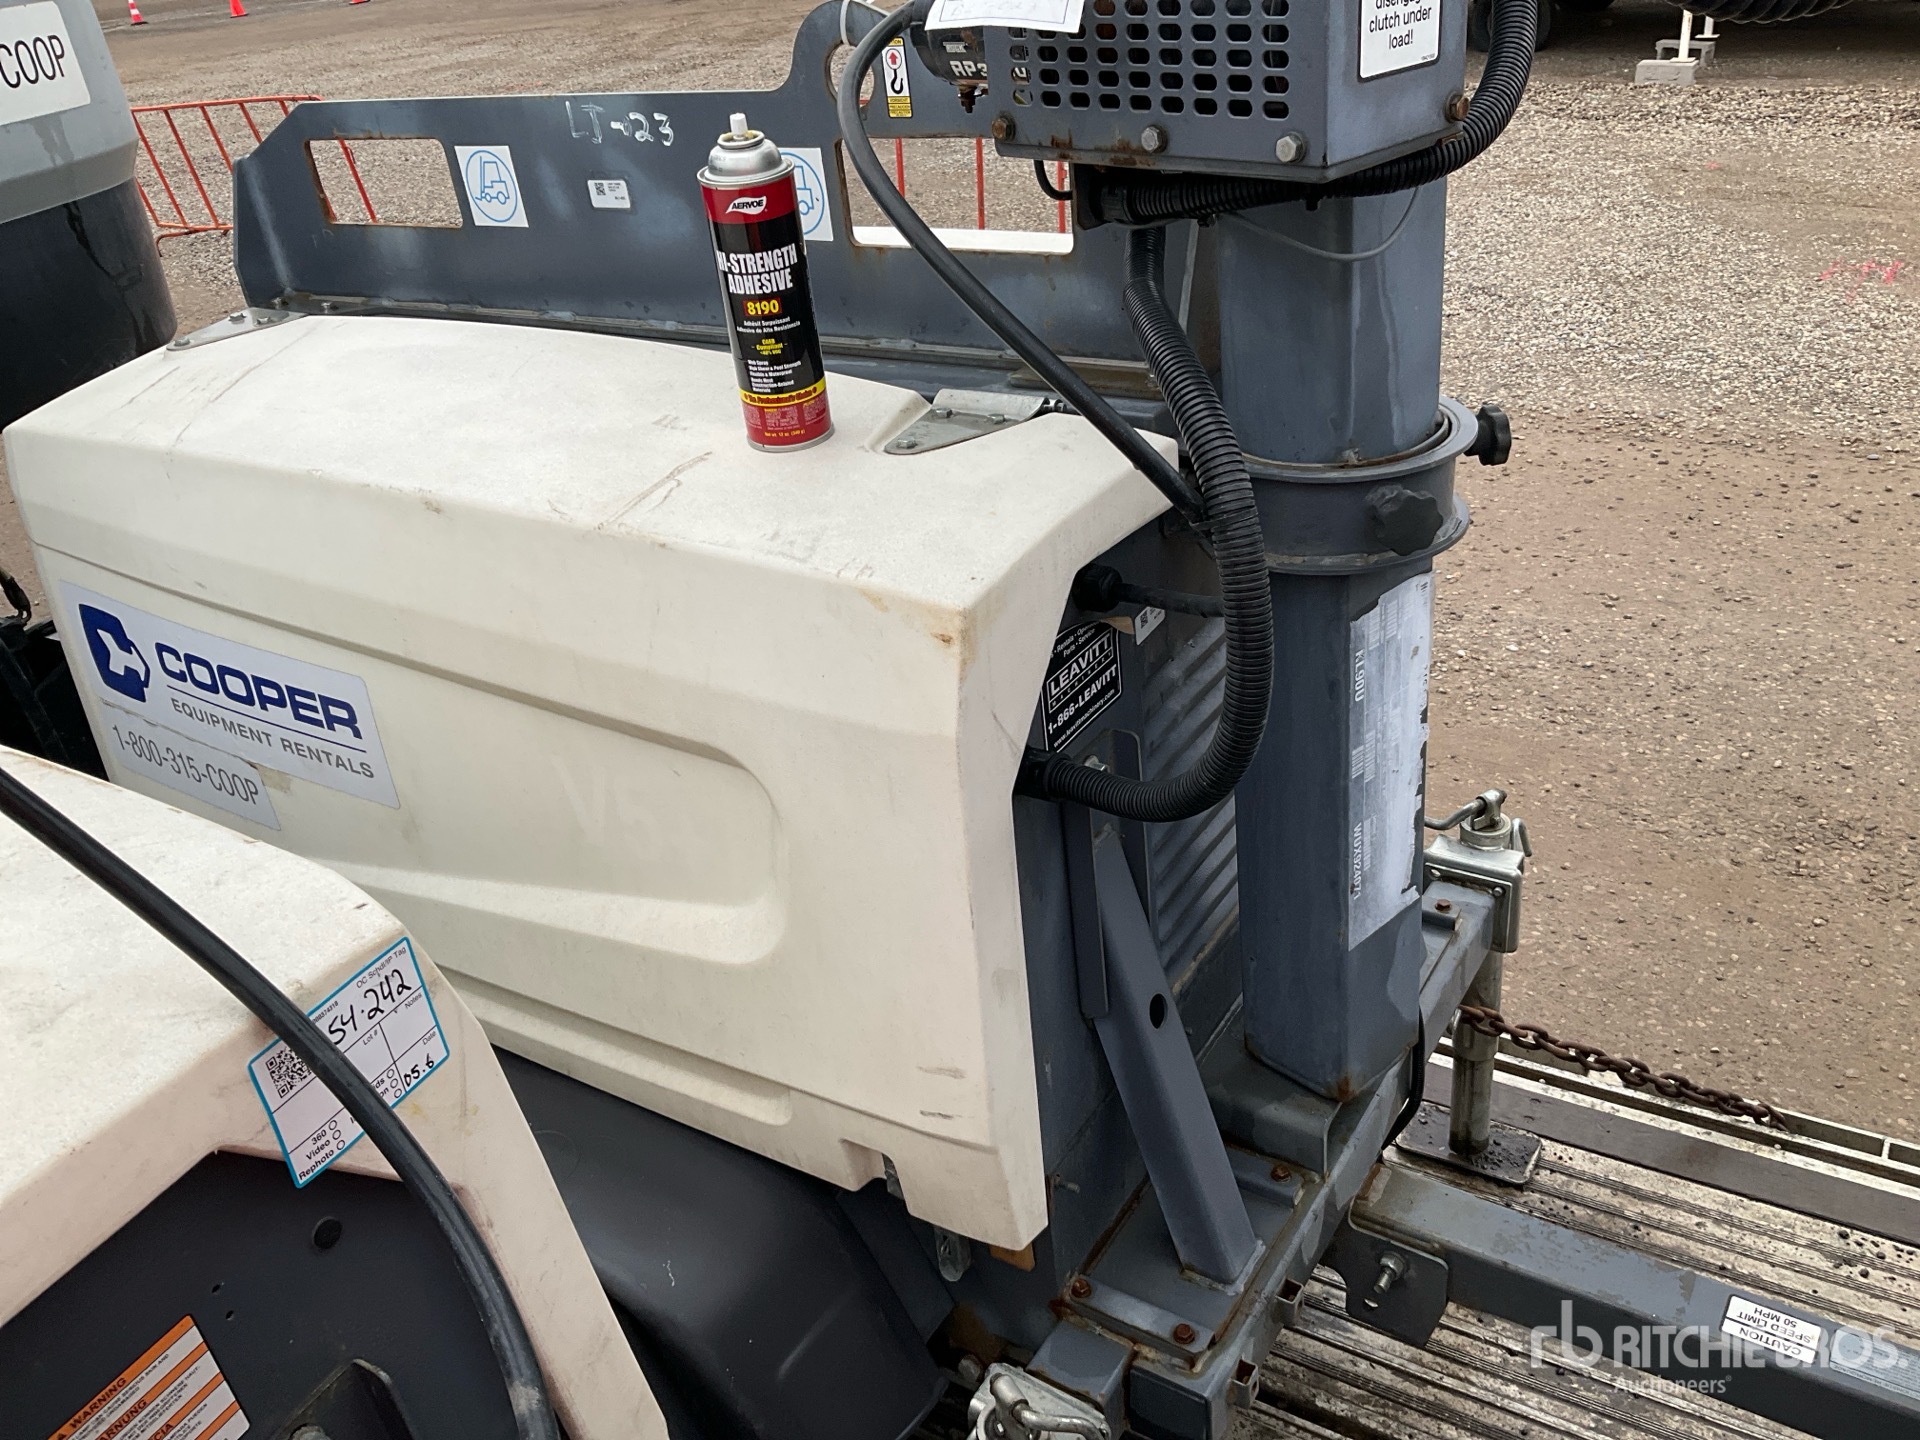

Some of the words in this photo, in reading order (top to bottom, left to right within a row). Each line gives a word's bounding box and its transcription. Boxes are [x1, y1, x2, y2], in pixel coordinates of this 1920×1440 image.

[1375, 0, 1421, 9] diseng
[1369, 11, 1400, 32] clutch
[1403, 6, 1432, 25] under
[1388, 29, 1413, 49] load!
[731, 199, 764, 210] AERVOE
[716, 243, 798, 274] HI-STRENGTH
[727, 268, 793, 295] ADHESIVE
[747, 299, 779, 316] 8190
[1050, 632, 1111, 697] LEAVITT
[1355, 649, 1365, 702] KL90U
[154, 641, 364, 740] COOPER
[1048, 663, 1117, 735] 1-866-LEAVITT
[1053, 688, 1115, 748] www.leavittmachinery.com
[170, 697, 273, 748] EQUIPMENT
[279, 736, 375, 779] RENTALS
[112, 724, 259, 805] 1-800-315-COOP
[393, 946, 407, 960] Tag
[404, 992, 423, 1010] Notes
[362, 1033, 374, 1046] Lot
[422, 1030, 437, 1046] Date
[311, 1129, 327, 1146] 360
[305, 1139, 331, 1161] Video
[297, 1149, 335, 1181] Rephoto
[1737, 1311, 1768, 1329] LIMIT
[1754, 1307, 1781, 1323] MPH
[1783, 1318, 1798, 1329] 50
[1739, 1327, 1802, 1356] CAUTION
[1770, 1323, 1812, 1344] SPEED
[158, 1353, 169, 1365] AND
[70, 1378, 127, 1429] WARNING
[99, 1399, 148, 1440] ARNUNG
